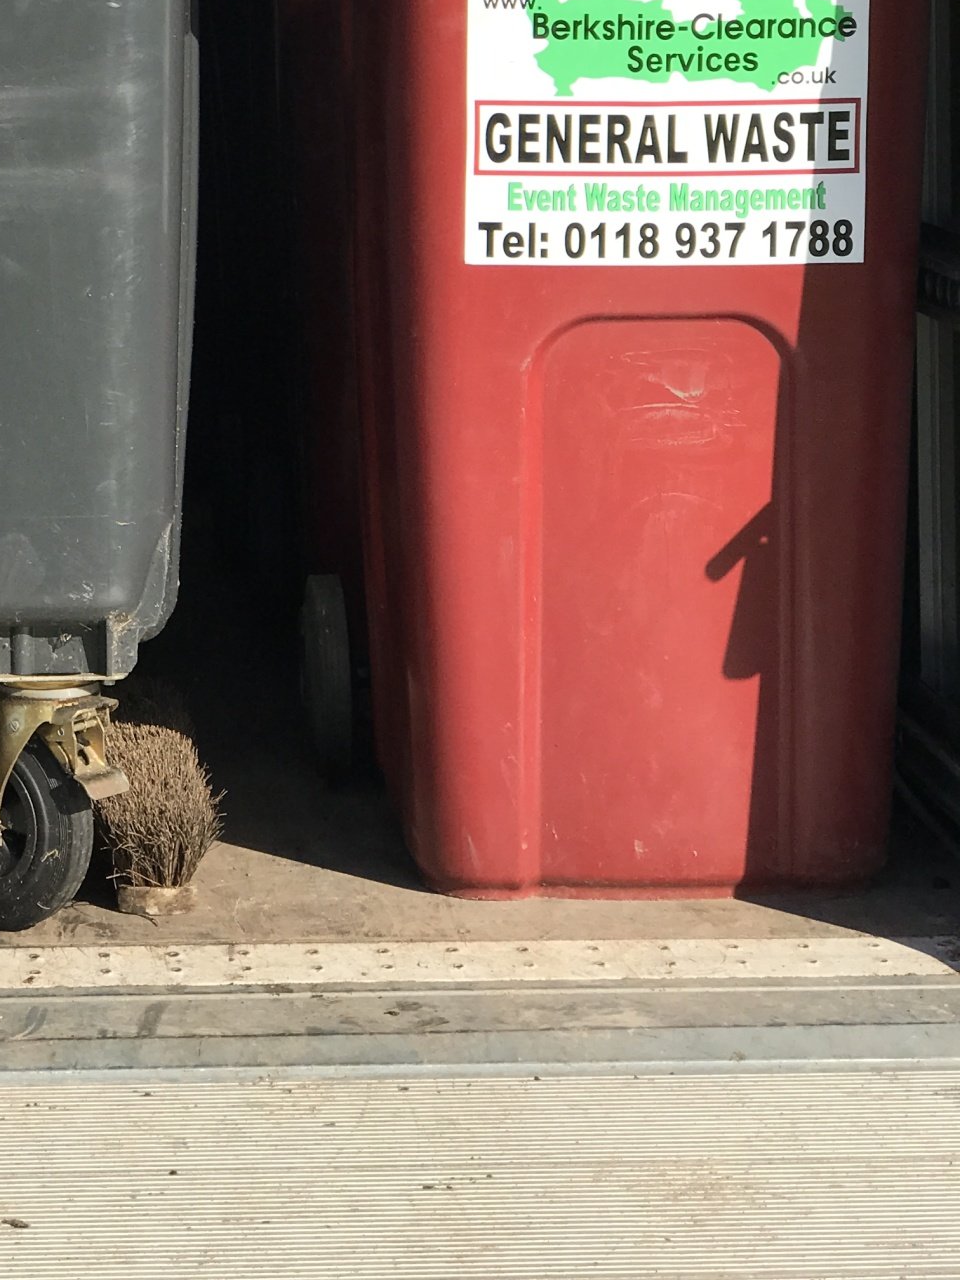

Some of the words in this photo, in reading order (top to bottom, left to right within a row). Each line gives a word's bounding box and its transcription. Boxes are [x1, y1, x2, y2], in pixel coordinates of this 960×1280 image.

[532, 10, 858, 41] Berkshire-Clearance
[627, 45, 759, 73] Services
[770, 67, 837, 86] .co.uk
[485, 111, 689, 164] GENERAL
[704, 111, 851, 163] WASTE
[508, 181, 577, 212] Event
[584, 182, 660, 212] Waste
[669, 181, 827, 219] Management
[478, 221, 549, 259] Tel:
[563, 221, 660, 260] 0118
[675, 221, 745, 259] 937
[761, 218, 853, 258] 1788
